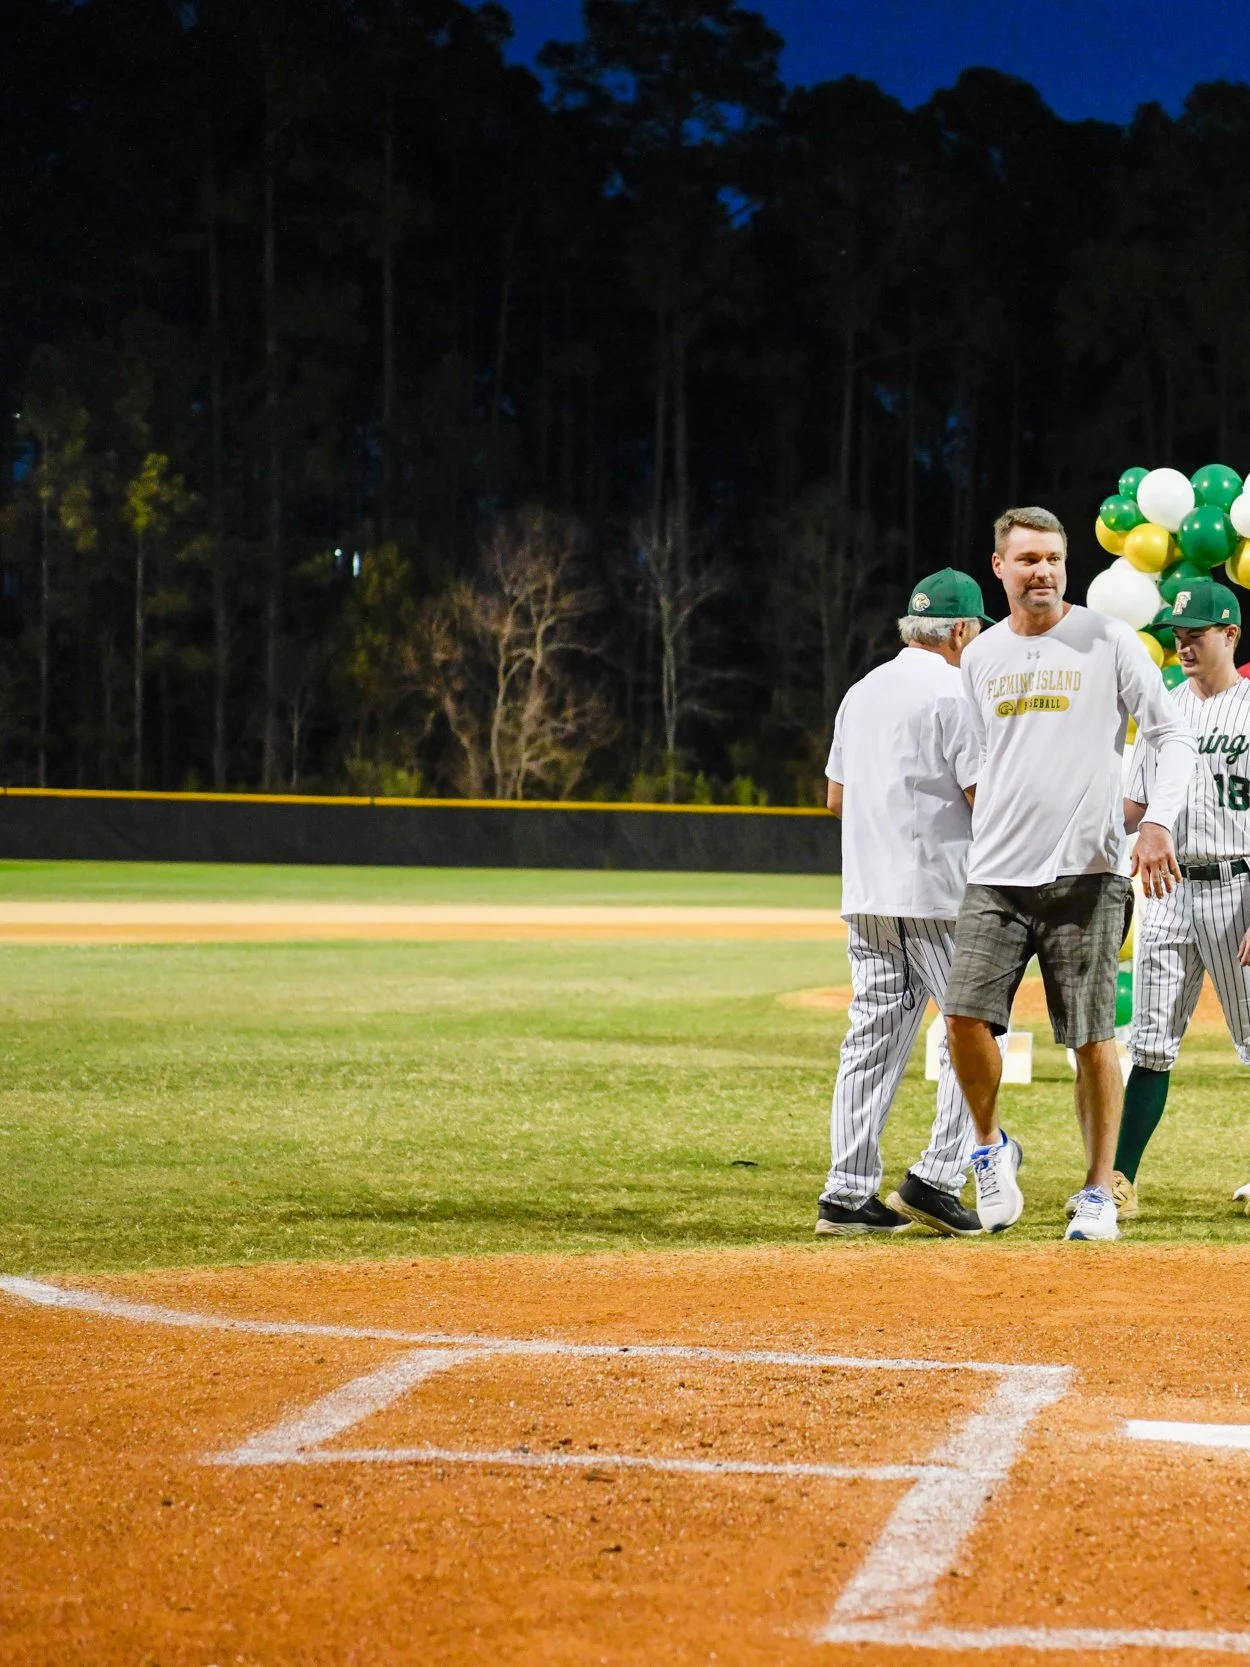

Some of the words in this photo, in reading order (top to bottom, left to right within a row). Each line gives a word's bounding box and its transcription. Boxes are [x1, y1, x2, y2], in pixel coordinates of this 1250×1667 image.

[1172, 591, 1192, 616] F
[987, 671, 1035, 700] FLEMING
[1036, 670, 1082, 692] ISLAND
[1024, 698, 1061, 711] SEBALL
[1213, 773, 1250, 812] 18
